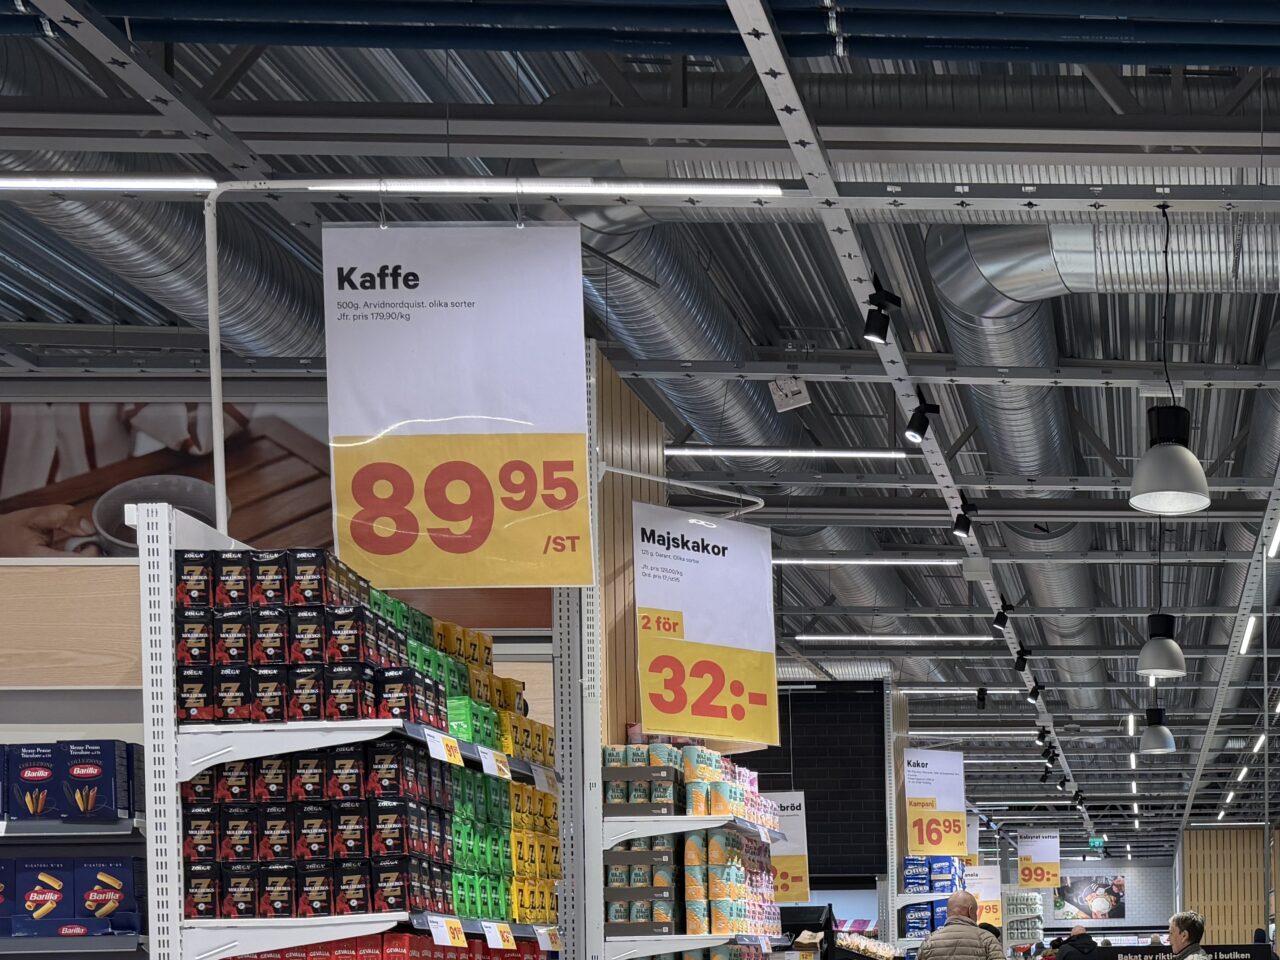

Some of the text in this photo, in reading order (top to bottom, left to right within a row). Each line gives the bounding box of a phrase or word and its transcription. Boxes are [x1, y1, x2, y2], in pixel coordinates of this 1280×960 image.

[337, 265, 420, 291] Kaffe
[429, 300, 448, 308] olika
[450, 299, 475, 308] sorter
[337, 313, 351, 321] Jfr.
[353, 312, 368, 321] pris
[542, 536, 580, 554] /ST
[641, 527, 728, 557] Majskakor
[641, 615, 679, 632] 2 för
[649, 655, 767, 721] 32:-
[907, 760, 929, 769] Kakor
[778, 803, 801, 812] bröd
[908, 800, 936, 809] Kampanj
[29, 892, 58, 901] Barilla
[89, 892, 119, 900] Barilla
[61, 926, 85, 934] Barilla
[1117, 953, 1142, 960] Bakat
[1155, 953, 1174, 960] rikti
